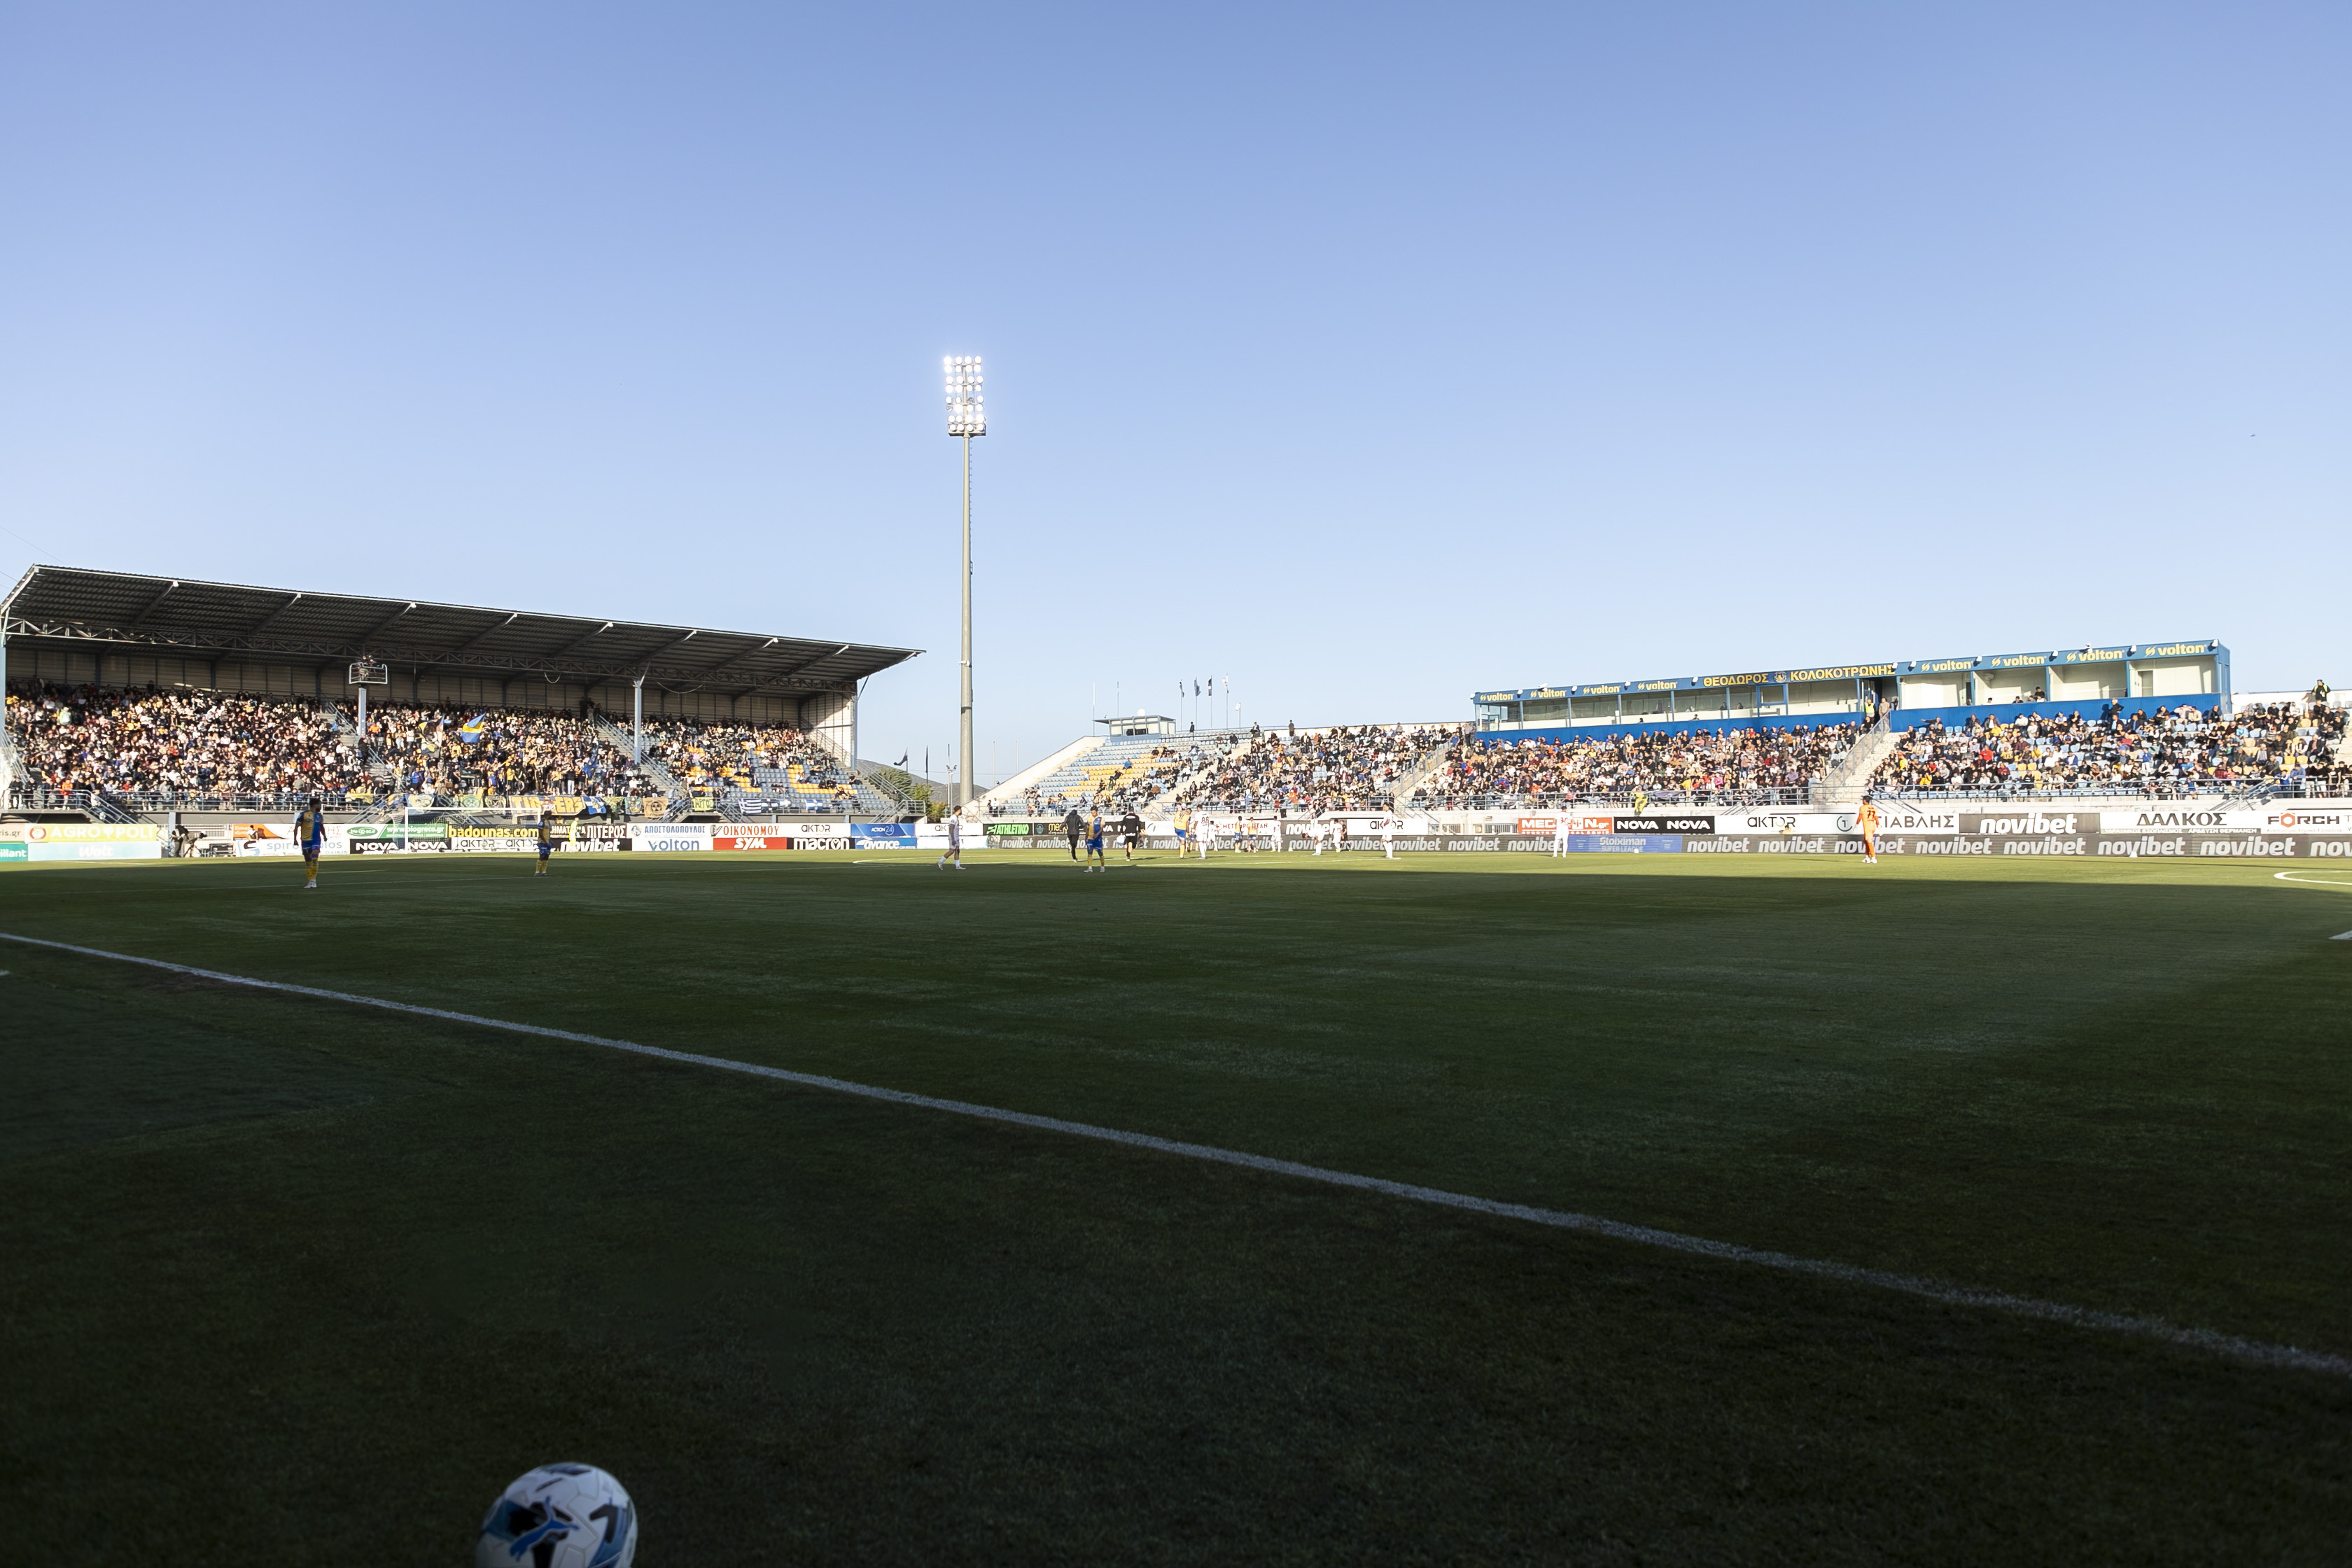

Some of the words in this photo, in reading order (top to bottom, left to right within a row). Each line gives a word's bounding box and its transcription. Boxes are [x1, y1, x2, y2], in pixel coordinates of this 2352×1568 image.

[2079, 650, 2122, 662] volton
[2158, 644, 2204, 657] volton
[1932, 660, 1972, 671] volton
[2003, 655, 2044, 666] volton
[1703, 673, 1769, 687] ΘΕΟΔΩΡΟΣ
[1791, 664, 1896, 682] ΚΟΛΟΚΟΤΡΩΝΗΣ
[1590, 685, 1620, 695] volton
[1646, 681, 1676, 691] volton
[1487, 693, 1513, 701] volton
[1538, 690, 1566, 699] volton
[1867, 811, 1875, 819] 77
[2136, 812, 2227, 826] ΔΑΛΚΟΣ
[1617, 820, 1659, 830] NOVA
[1667, 820, 1710, 830] NOVA
[1980, 813, 2078, 834] novibet
[449, 826, 538, 838] badounas.com
[587, 825, 626, 838] ΠΙΤΕΡΟΣ
[723, 825, 778, 835] ΟΙΚΟΝΟΜΟΥ
[996, 825, 1029, 834] ATHLETIKO
[356, 842, 398, 850] NOVA
[407, 841, 447, 850] NOVA
[648, 839, 699, 850] volton
[793, 837, 849, 850] macron
[864, 840, 900, 850] avance
[1002, 837, 1032, 848] novibet
[1393, 836, 1441, 850] novibet
[1448, 836, 1499, 850] novibet
[1600, 836, 1647, 846] Stoiximan
[1687, 836, 1749, 853] novibet
[1758, 836, 1825, 853] novibet
[1915, 836, 1992, 855] novibet
[2003, 836, 2086, 855] novibet
[2098, 836, 2185, 855] novibet
[2199, 836, 2295, 856] novibet
